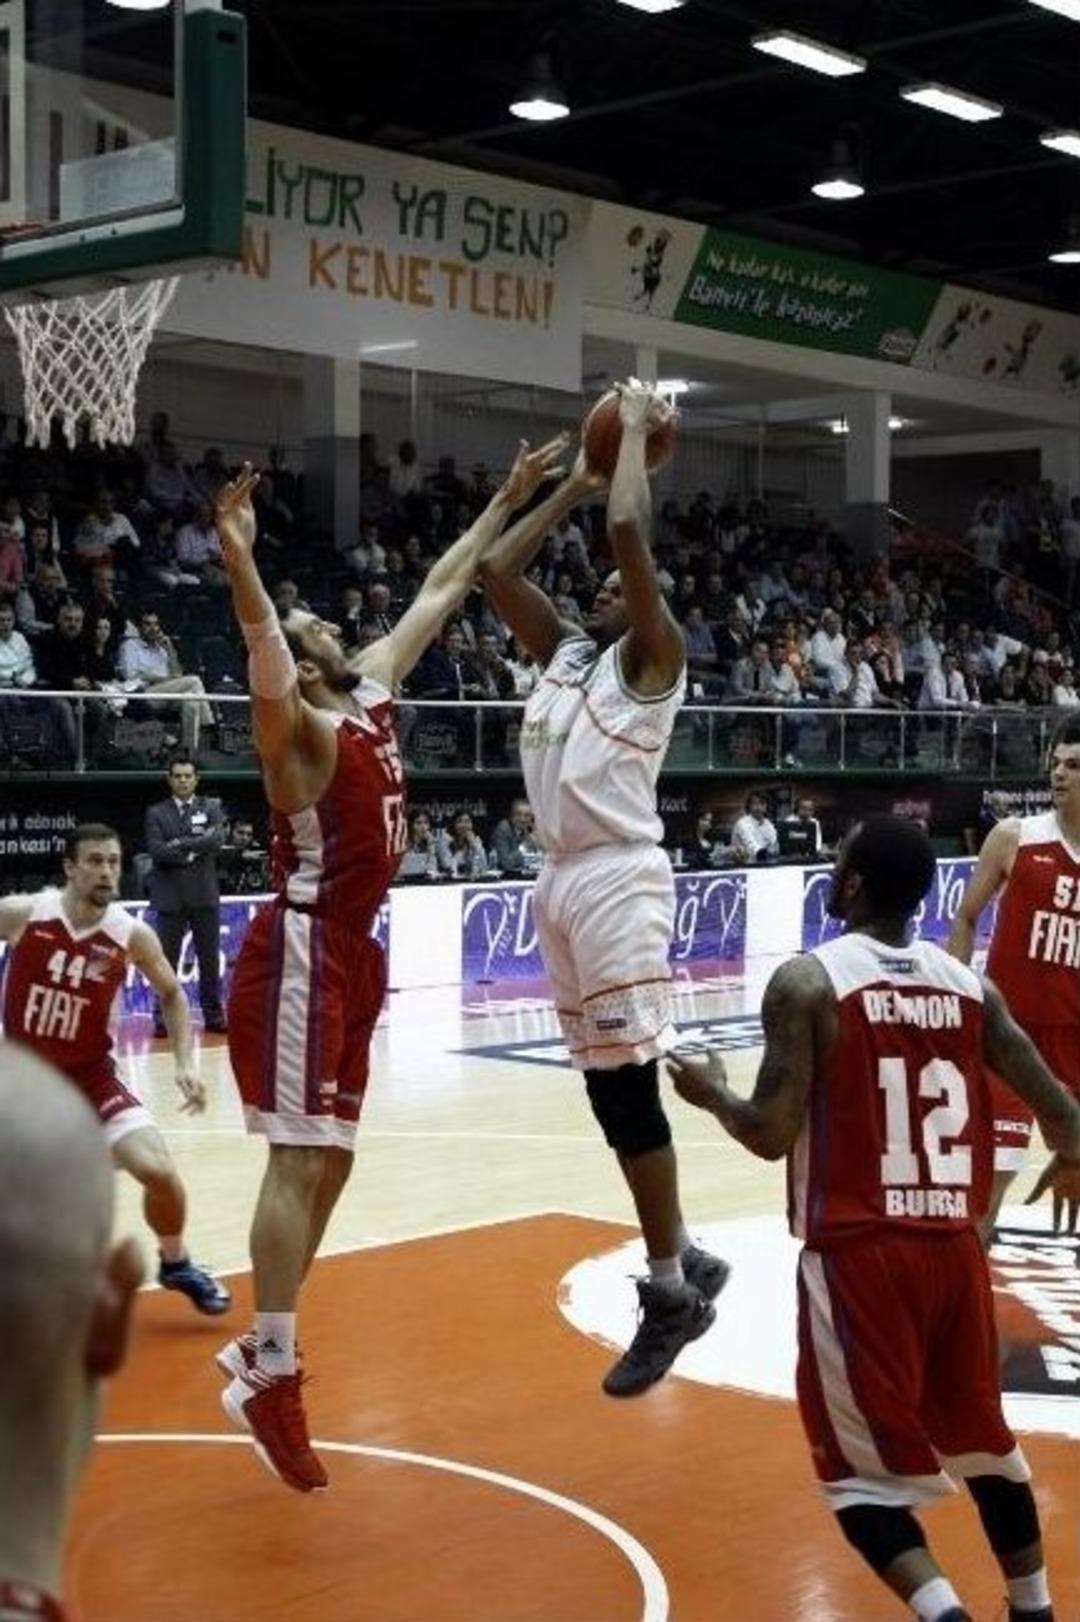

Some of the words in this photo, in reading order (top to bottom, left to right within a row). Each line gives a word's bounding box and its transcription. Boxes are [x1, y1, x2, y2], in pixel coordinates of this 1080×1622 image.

[392, 181, 447, 241] YA
[461, 196, 568, 268] SEN?
[310, 238, 554, 330] KENETLEN!
[47, 950, 86, 989] 44
[24, 983, 91, 1040] FIAT
[878, 1057, 972, 1185] 12
[885, 1189, 968, 1219] BURSA
